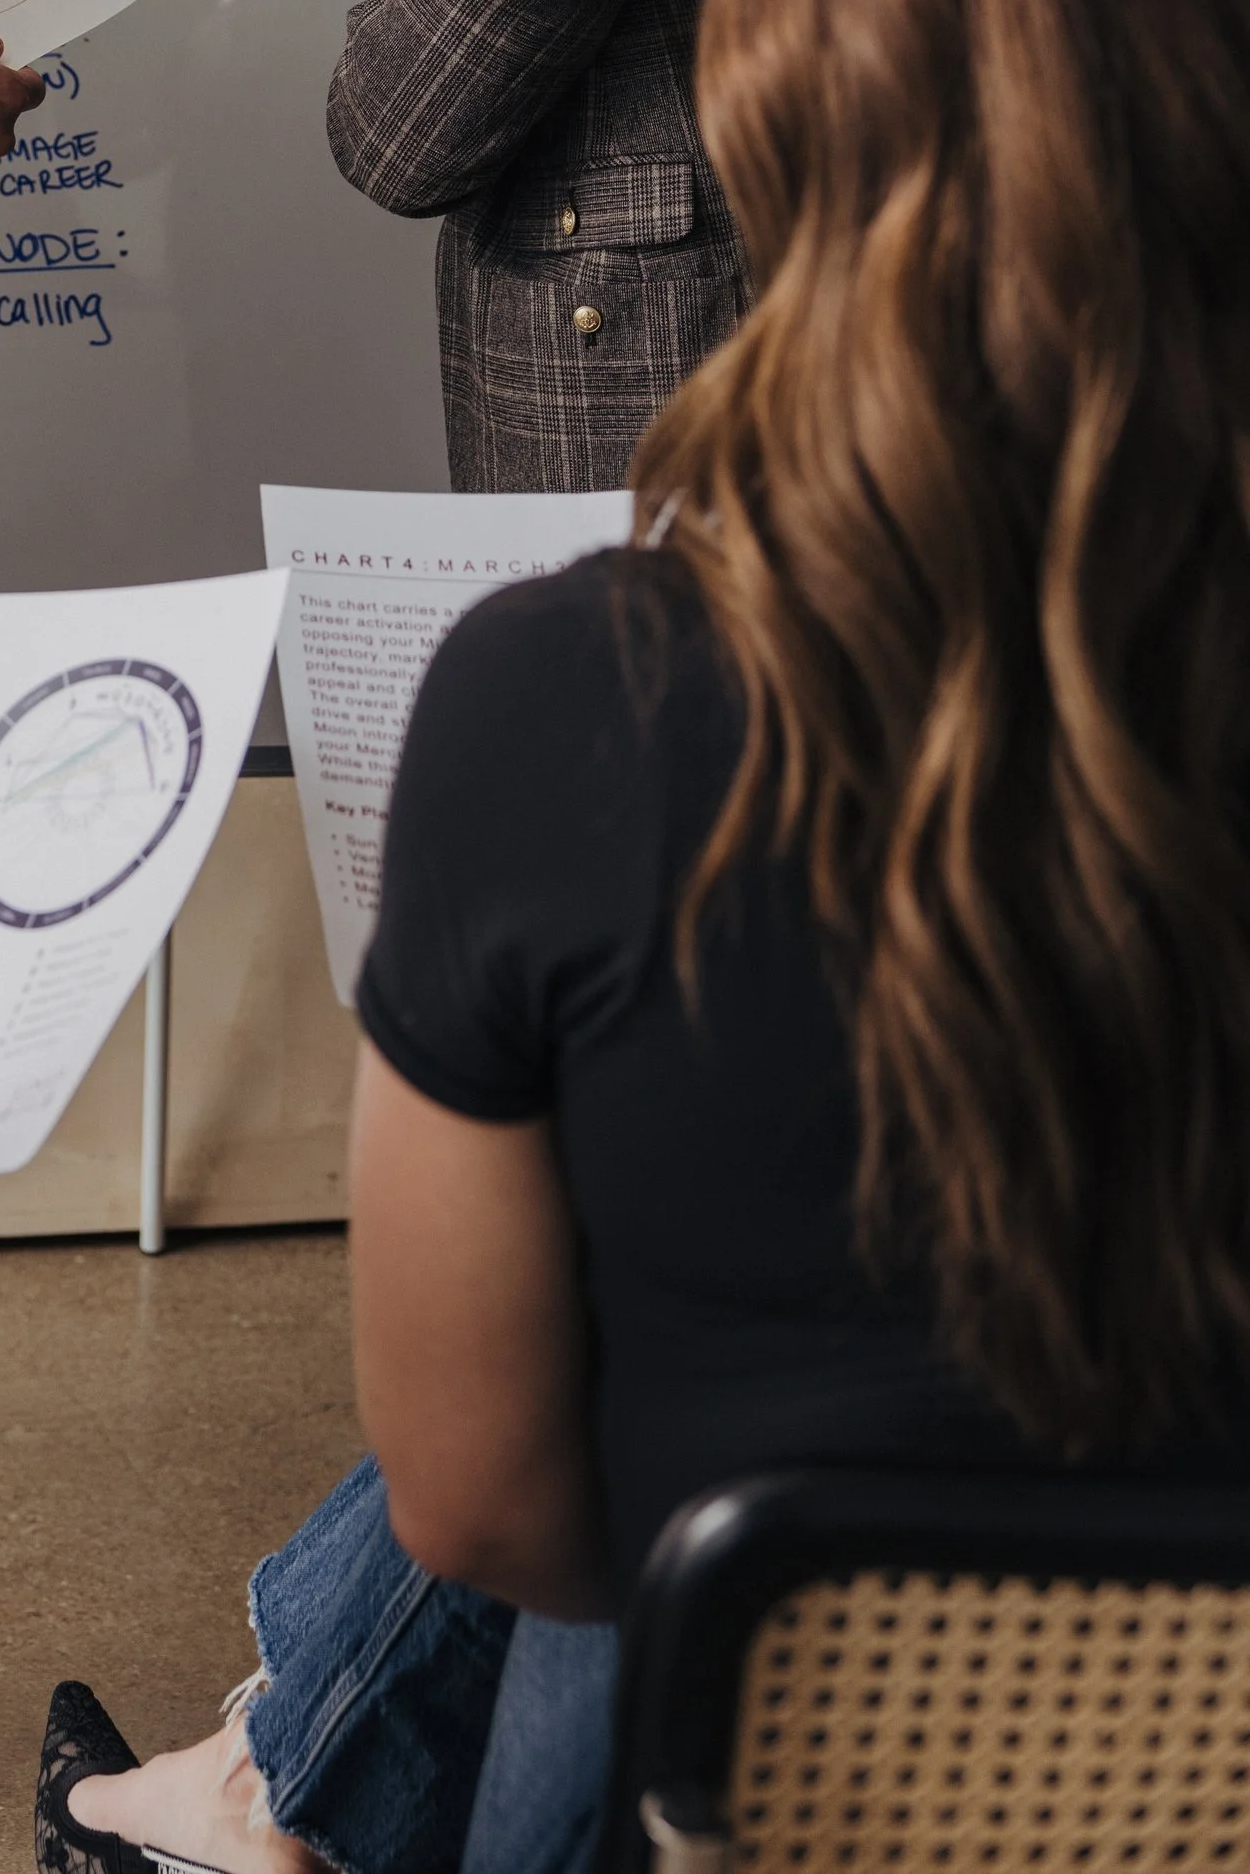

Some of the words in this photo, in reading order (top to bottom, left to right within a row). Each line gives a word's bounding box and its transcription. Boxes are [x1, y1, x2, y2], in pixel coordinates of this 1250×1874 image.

[0, 159, 124, 197] CAREER
[299, 594, 332, 608] This
[338, 598, 378, 612] chart
[383, 603, 438, 616] carries
[444, 608, 453, 617] a
[300, 613, 350, 626] career
[356, 617, 432, 633] activation
[302, 628, 374, 646] opposing
[380, 635, 414, 648] your
[308, 677, 360, 690] appeal
[367, 682, 395, 695] and
[310, 690, 339, 704] The
[345, 695, 398, 710] overall
[311, 707, 350, 721] drive
[356, 712, 386, 725] and
[313, 721, 358, 738] Moon
[315, 739, 349, 751] your
[317, 753, 363, 769] While
[325, 799, 355, 817] Key
